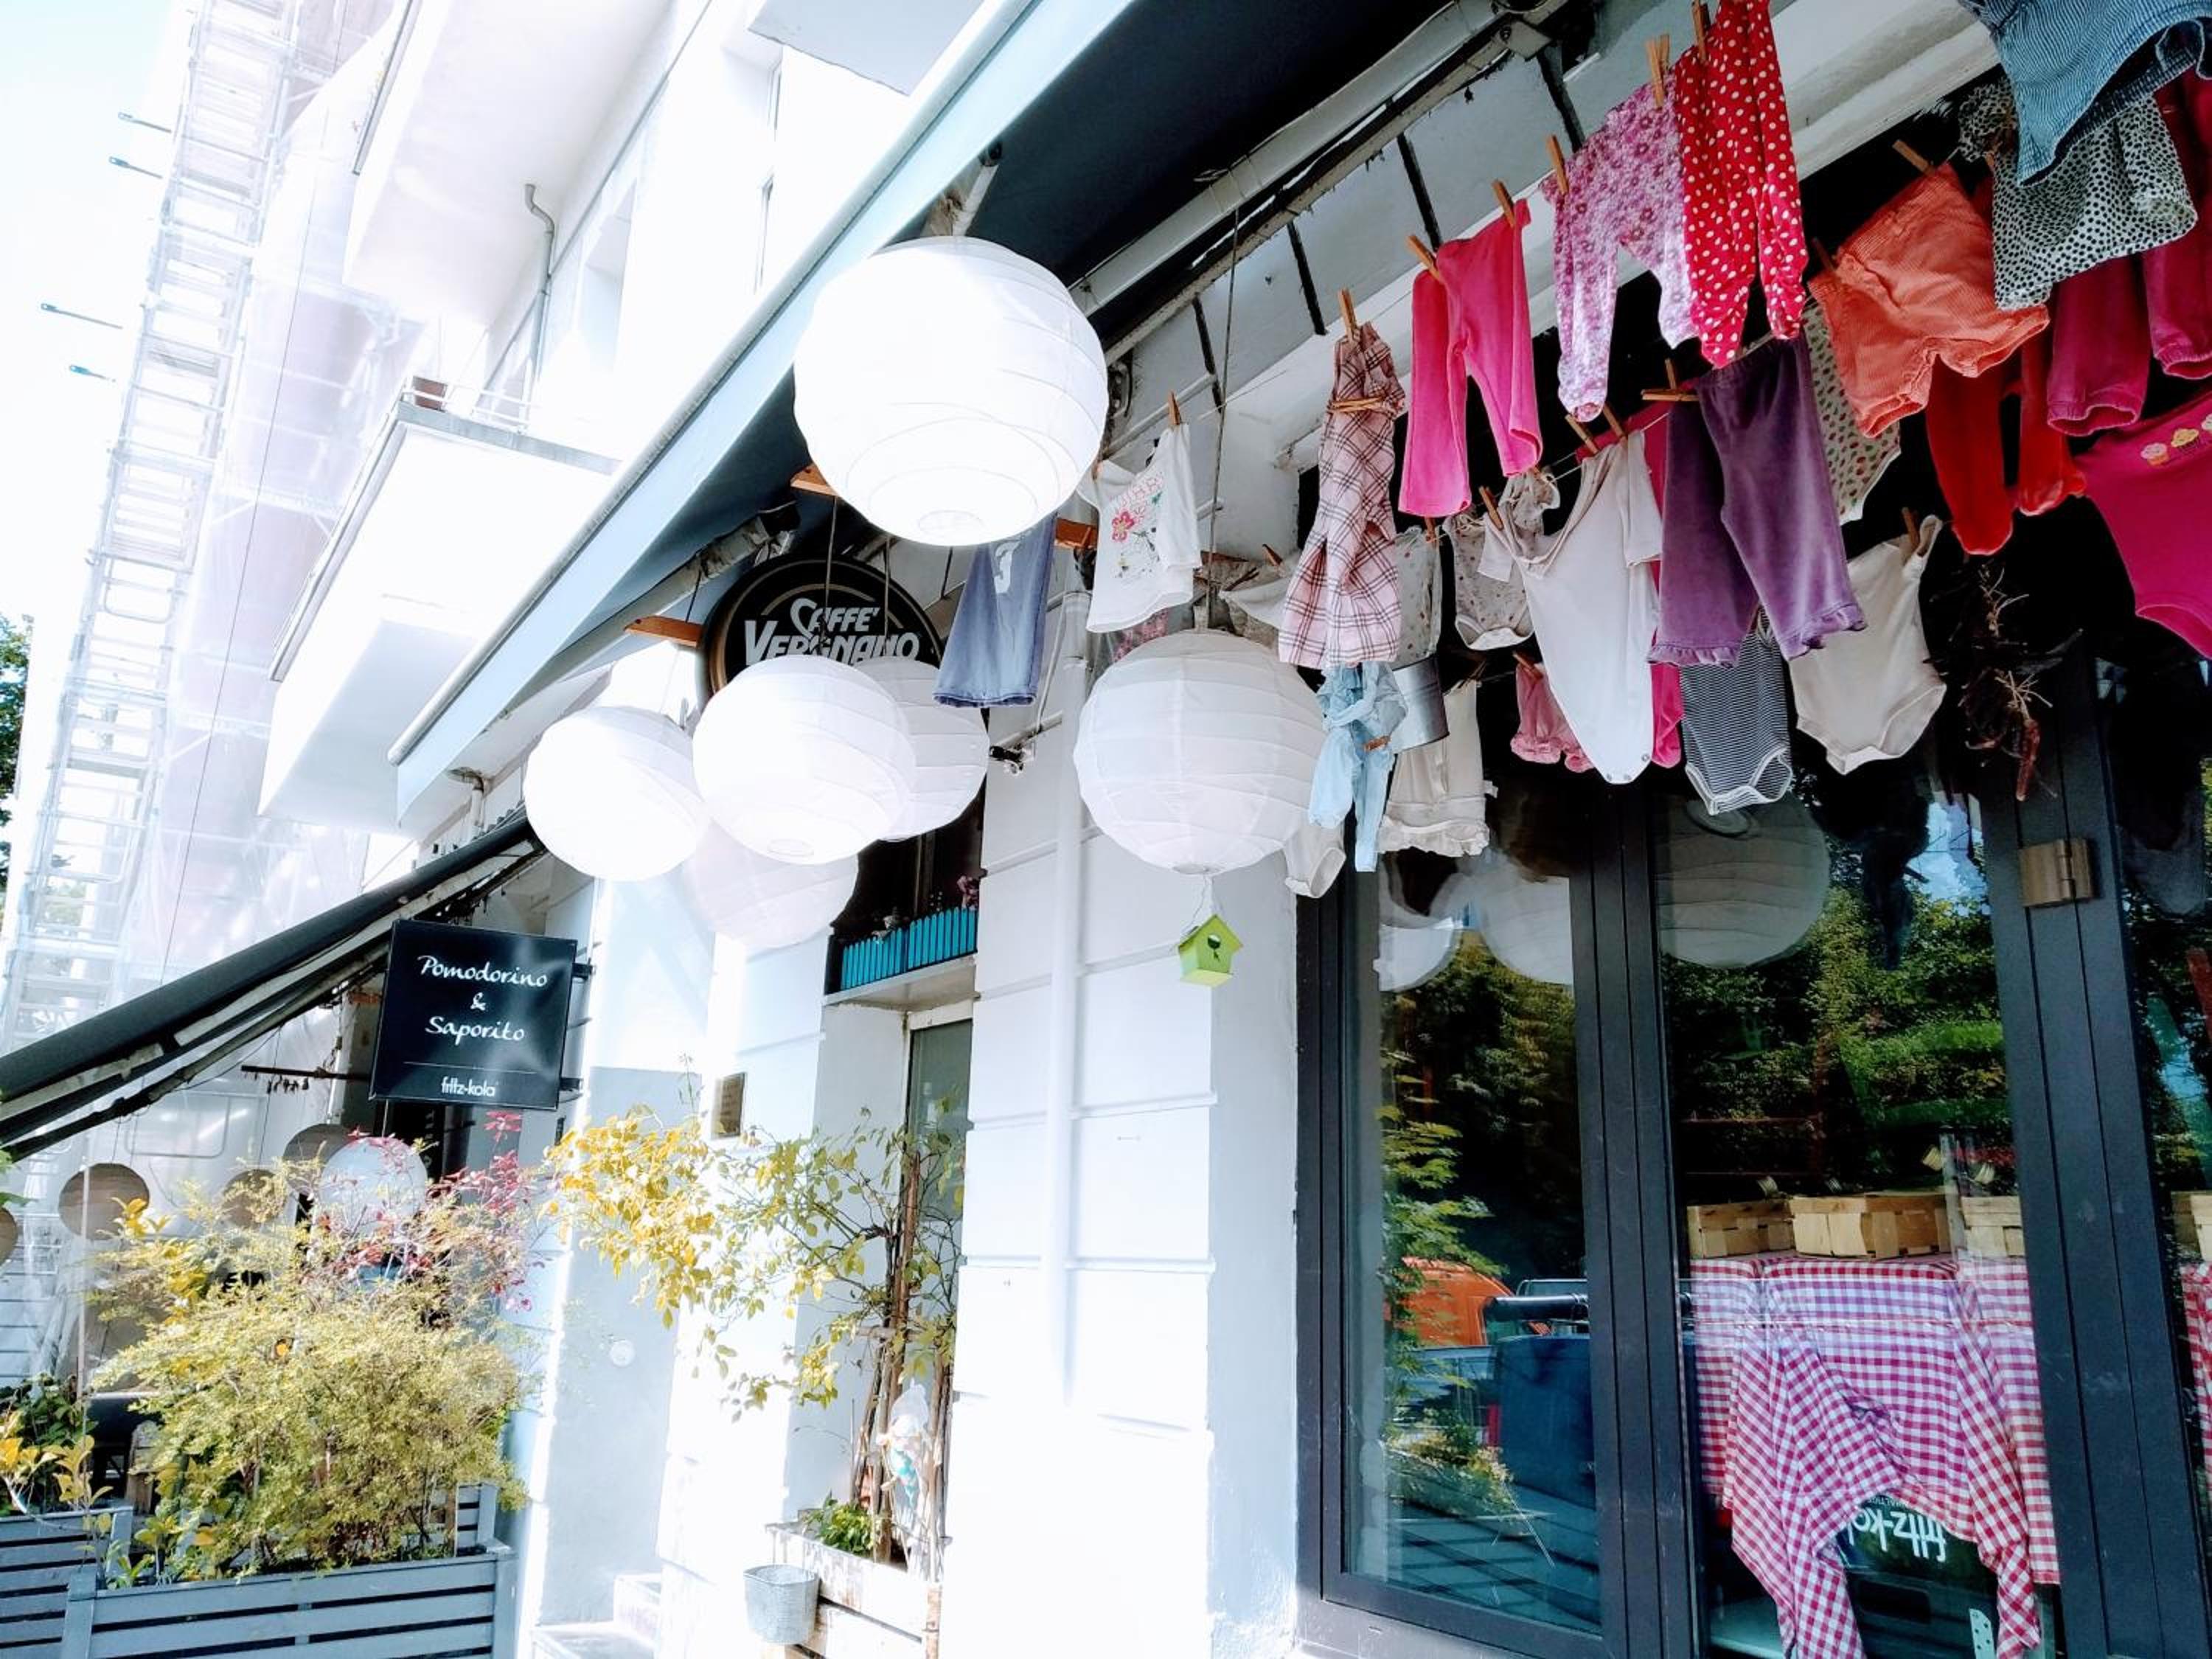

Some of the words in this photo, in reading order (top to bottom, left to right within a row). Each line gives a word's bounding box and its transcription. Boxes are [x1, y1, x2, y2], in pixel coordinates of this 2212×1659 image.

[417, 955, 548, 987] Pomodorino
[470, 992, 487, 1011] &
[425, 1016, 524, 1046] Saporito
[441, 1076, 496, 1096] fritz-kola
[1848, 1506, 1947, 1562] fritz-kol
